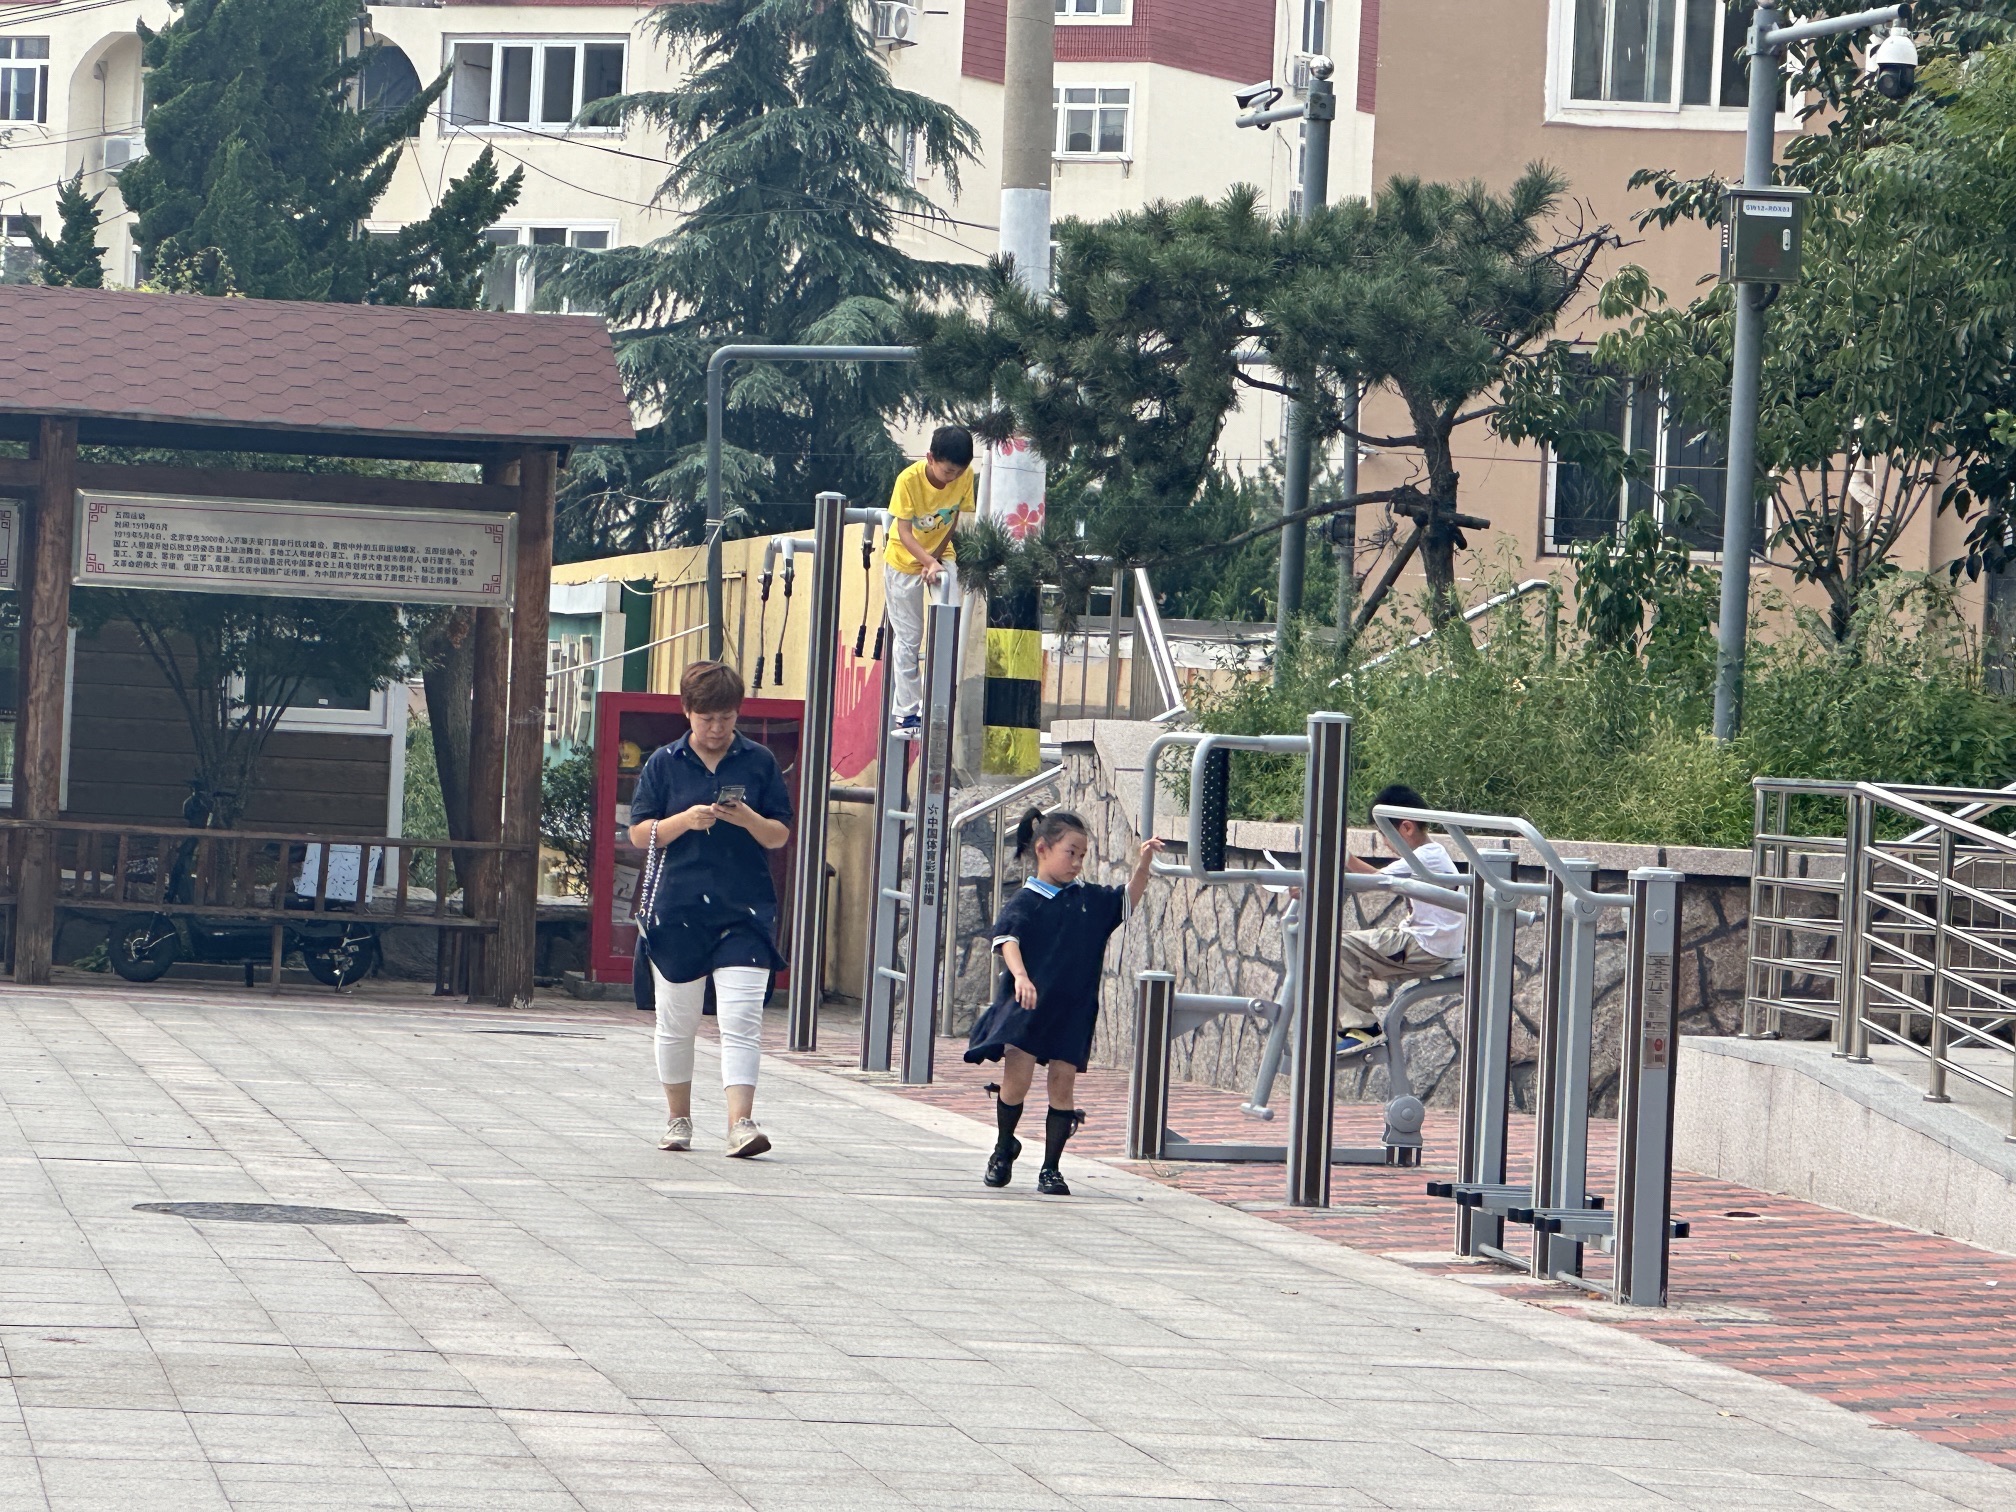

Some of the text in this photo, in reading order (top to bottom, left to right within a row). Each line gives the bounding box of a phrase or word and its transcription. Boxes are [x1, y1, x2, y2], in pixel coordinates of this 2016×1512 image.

[923, 816, 939, 906] 中国体育彩票捐赠
